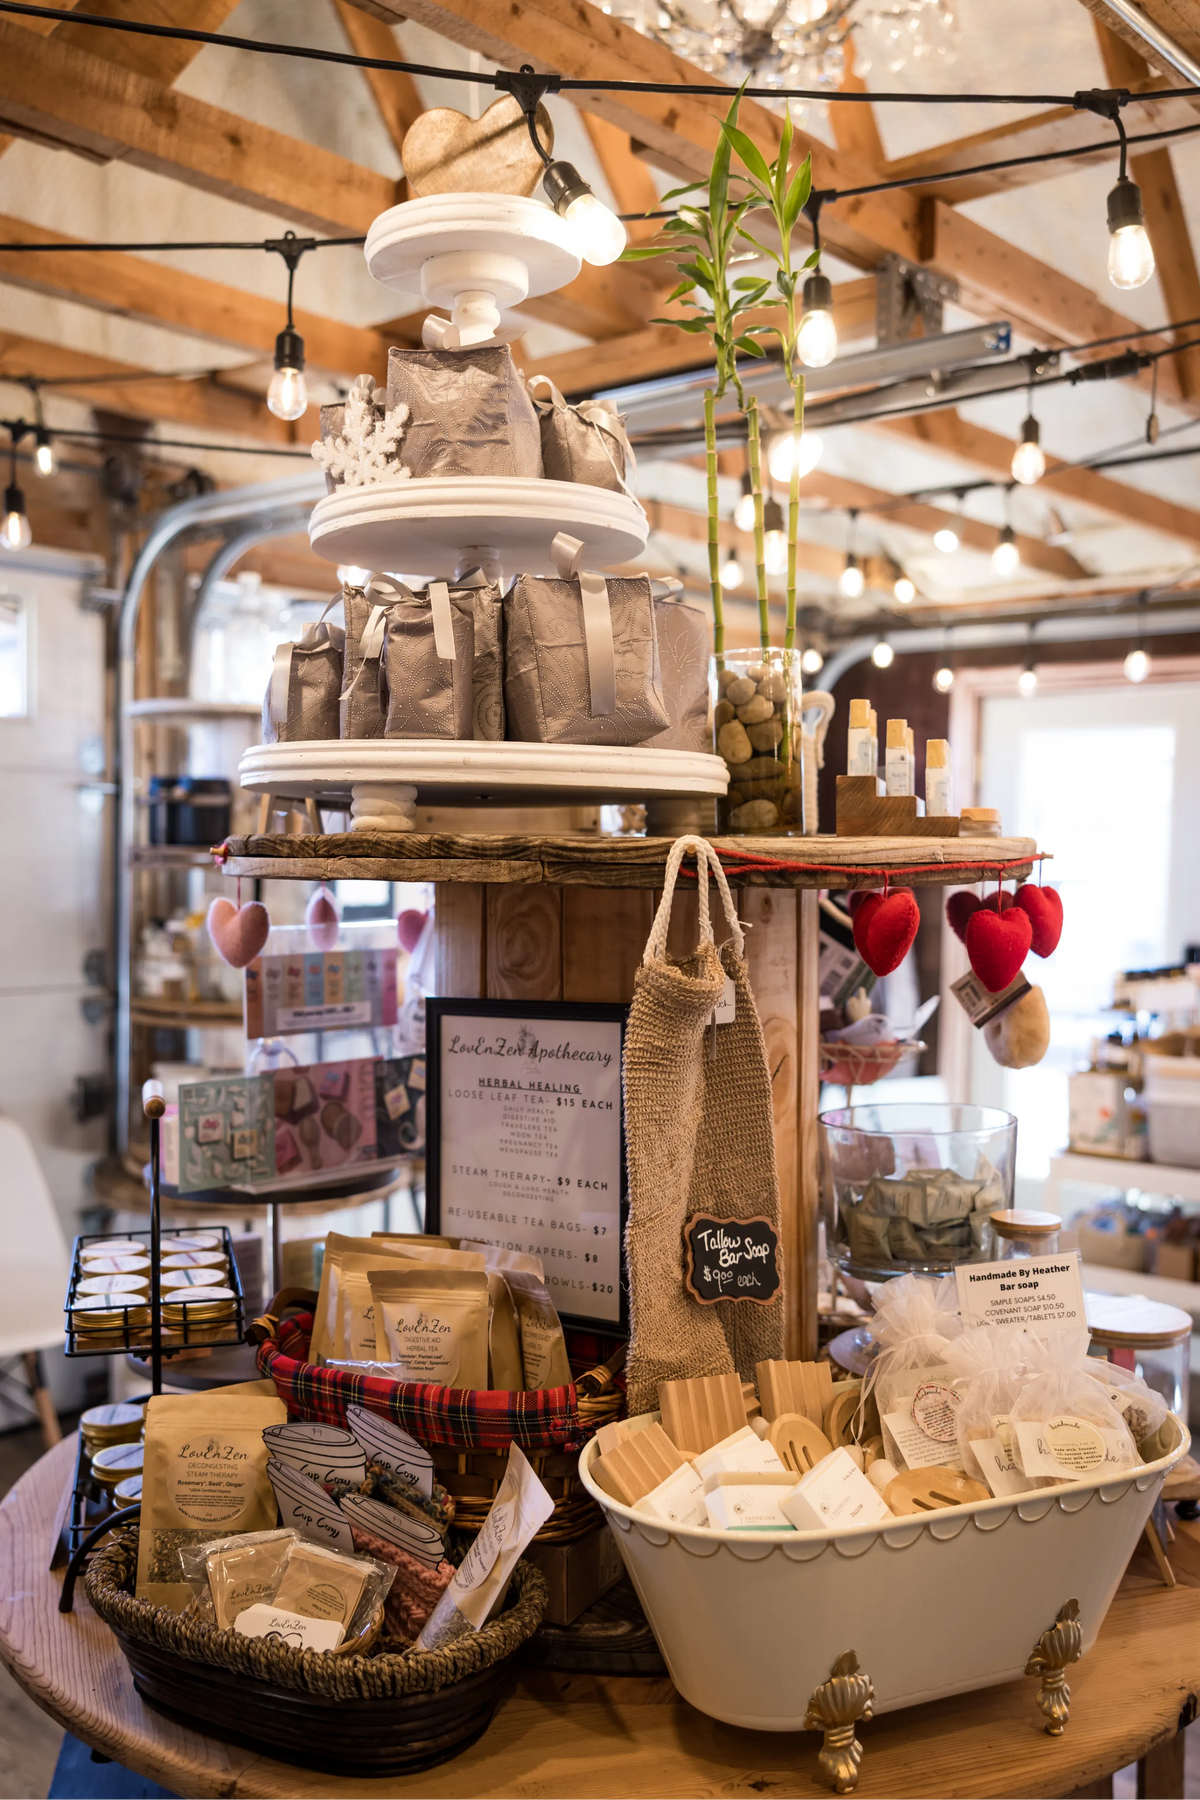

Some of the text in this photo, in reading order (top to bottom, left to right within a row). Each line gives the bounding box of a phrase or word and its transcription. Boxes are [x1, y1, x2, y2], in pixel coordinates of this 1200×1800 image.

[448, 1034, 613, 1067] LovEnZen Apothecary
[478, 1077, 581, 1093] HERBAL HEALING
[448, 1088, 613, 1110] LOOSE LEAF TEA- $15 EACH
[503, 1105, 555, 1115] DAILY HEALTH
[502, 1113, 556, 1124] DIGESTIVE AID
[501, 1121, 558, 1132] TRAVELERS TEA
[510, 1131, 548, 1140] MOON TEA
[500, 1138, 558, 1150] PREGNANCY TEA
[500, 1147, 559, 1158] MENOPAUSE TEA
[452, 1165, 608, 1190] STEAM THERAPY- $9 EACH
[489, 1181, 512, 1190] COUGH
[522, 1184, 540, 1192] LUNG
[543, 1188, 569, 1196] HEALTH
[503, 1190, 555, 1202] DECONGESTING
[448, 1206, 518, 1224] RE-USEABLE
[524, 1216, 544, 1227] TEA
[593, 1225, 607, 1235] $7
[697, 1228, 741, 1251] Tallow
[460, 1236, 598, 1263] NTION PAPERS- $8
[719, 1237, 770, 1268] Bar Soap
[737, 1271, 761, 1287] each
[969, 1264, 1070, 1282] Handmade By Heather
[1000, 1280, 1039, 1291] Bar soap
[990, 1298, 1012, 1306] SIMPLE
[1014, 1295, 1036, 1304] SOAPS
[985, 1306, 1022, 1317] COVENANT
[1023, 1305, 1042, 1313] SOAP
[995, 1312, 1056, 1325] SWEATER/TABLETS
[395, 1318, 452, 1334] LovEnZen
[404, 1336, 441, 1344] DIGESTIVE AID
[1048, 1420, 1080, 1430] handmade
[177, 1444, 249, 1460] LovEnZen
[188, 1462, 238, 1470] DECONGESTING
[371, 1451, 419, 1486] Cup Cozy
[210, 1471, 239, 1479] THERAPY
[292, 1506, 340, 1539] Cup Cozy
[268, 1618, 307, 1631] LovEnZen
